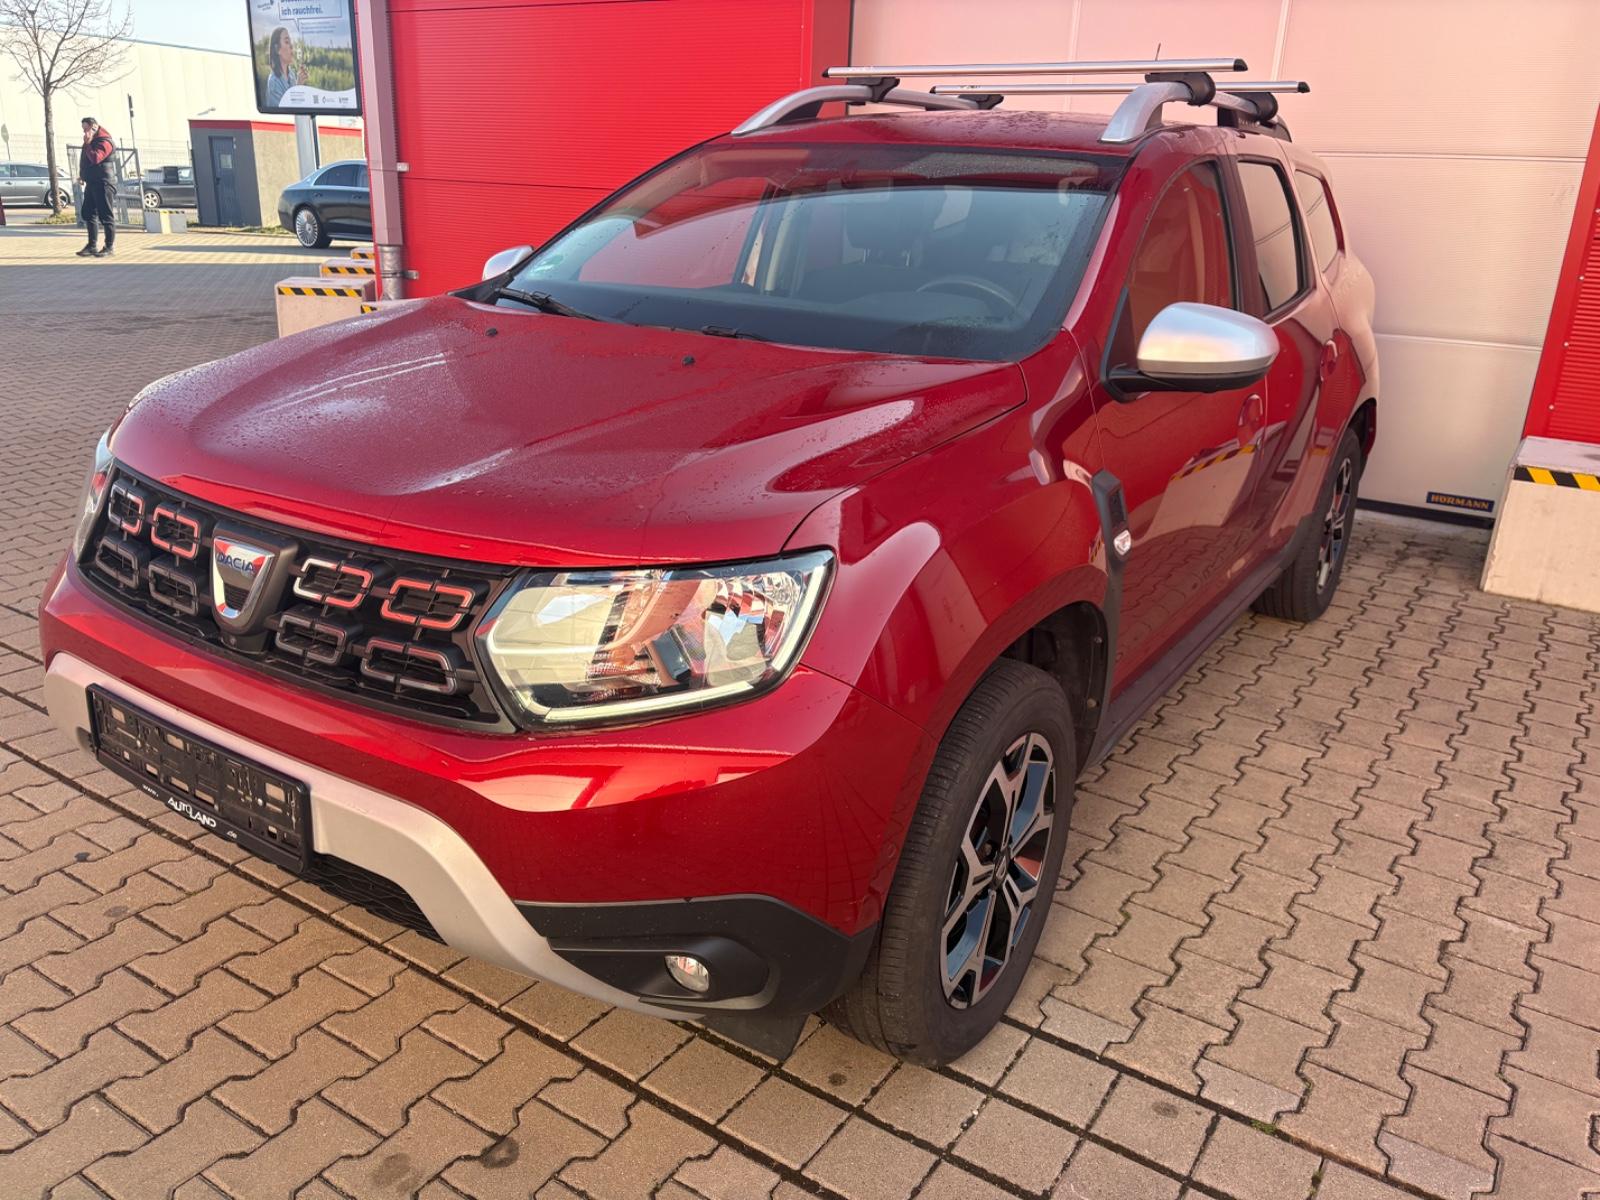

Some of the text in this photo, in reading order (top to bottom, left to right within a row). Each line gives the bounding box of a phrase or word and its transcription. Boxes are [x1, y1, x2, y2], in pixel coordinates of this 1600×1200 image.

[281, 7, 291, 16] ich
[216, 551, 255, 571] DACIA
[167, 797, 217, 828] AUTOLAND
